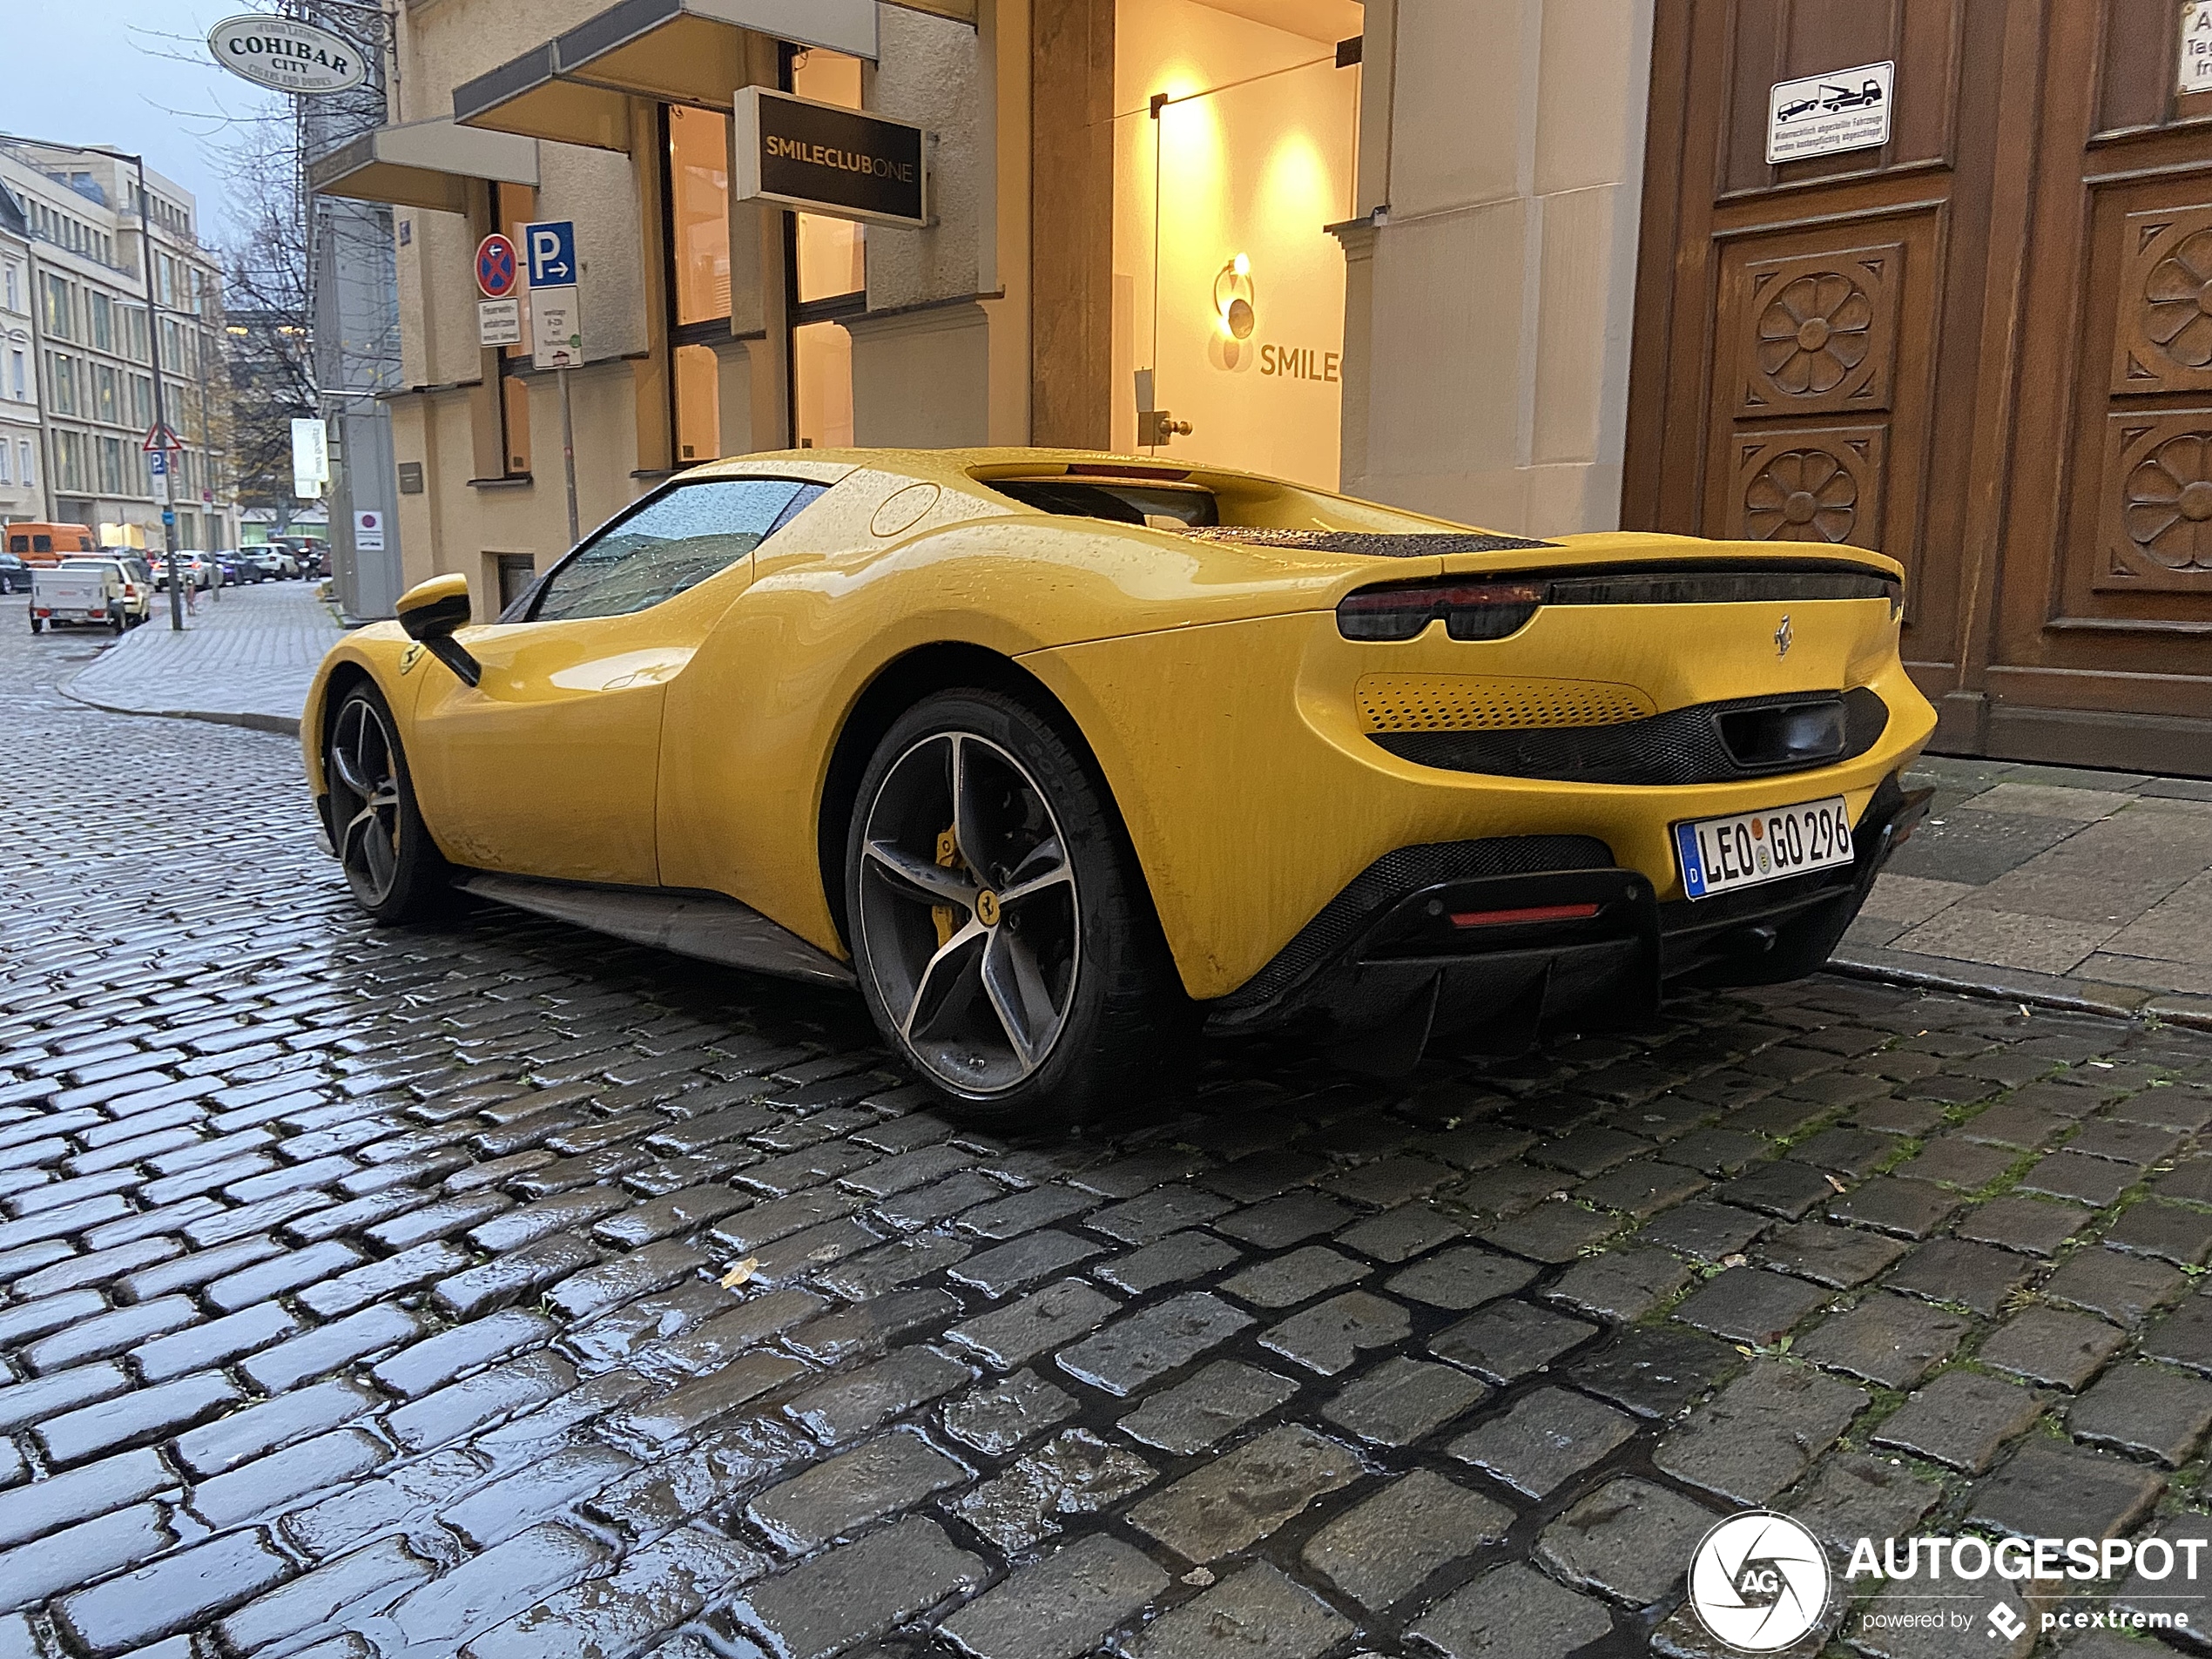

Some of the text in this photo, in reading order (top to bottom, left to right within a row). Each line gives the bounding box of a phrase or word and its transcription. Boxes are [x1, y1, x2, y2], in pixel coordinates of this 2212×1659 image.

[229, 37, 347, 76] COHIBAR
[272, 57, 309, 74] CITY
[2195, 59, 2212, 77] fr
[533, 231, 561, 280] P
[1260, 344, 1342, 383] SMILE
[152, 454, 162, 470] P
[1700, 806, 1849, 884] LEO GO 296
[1689, 867, 1699, 884] D
